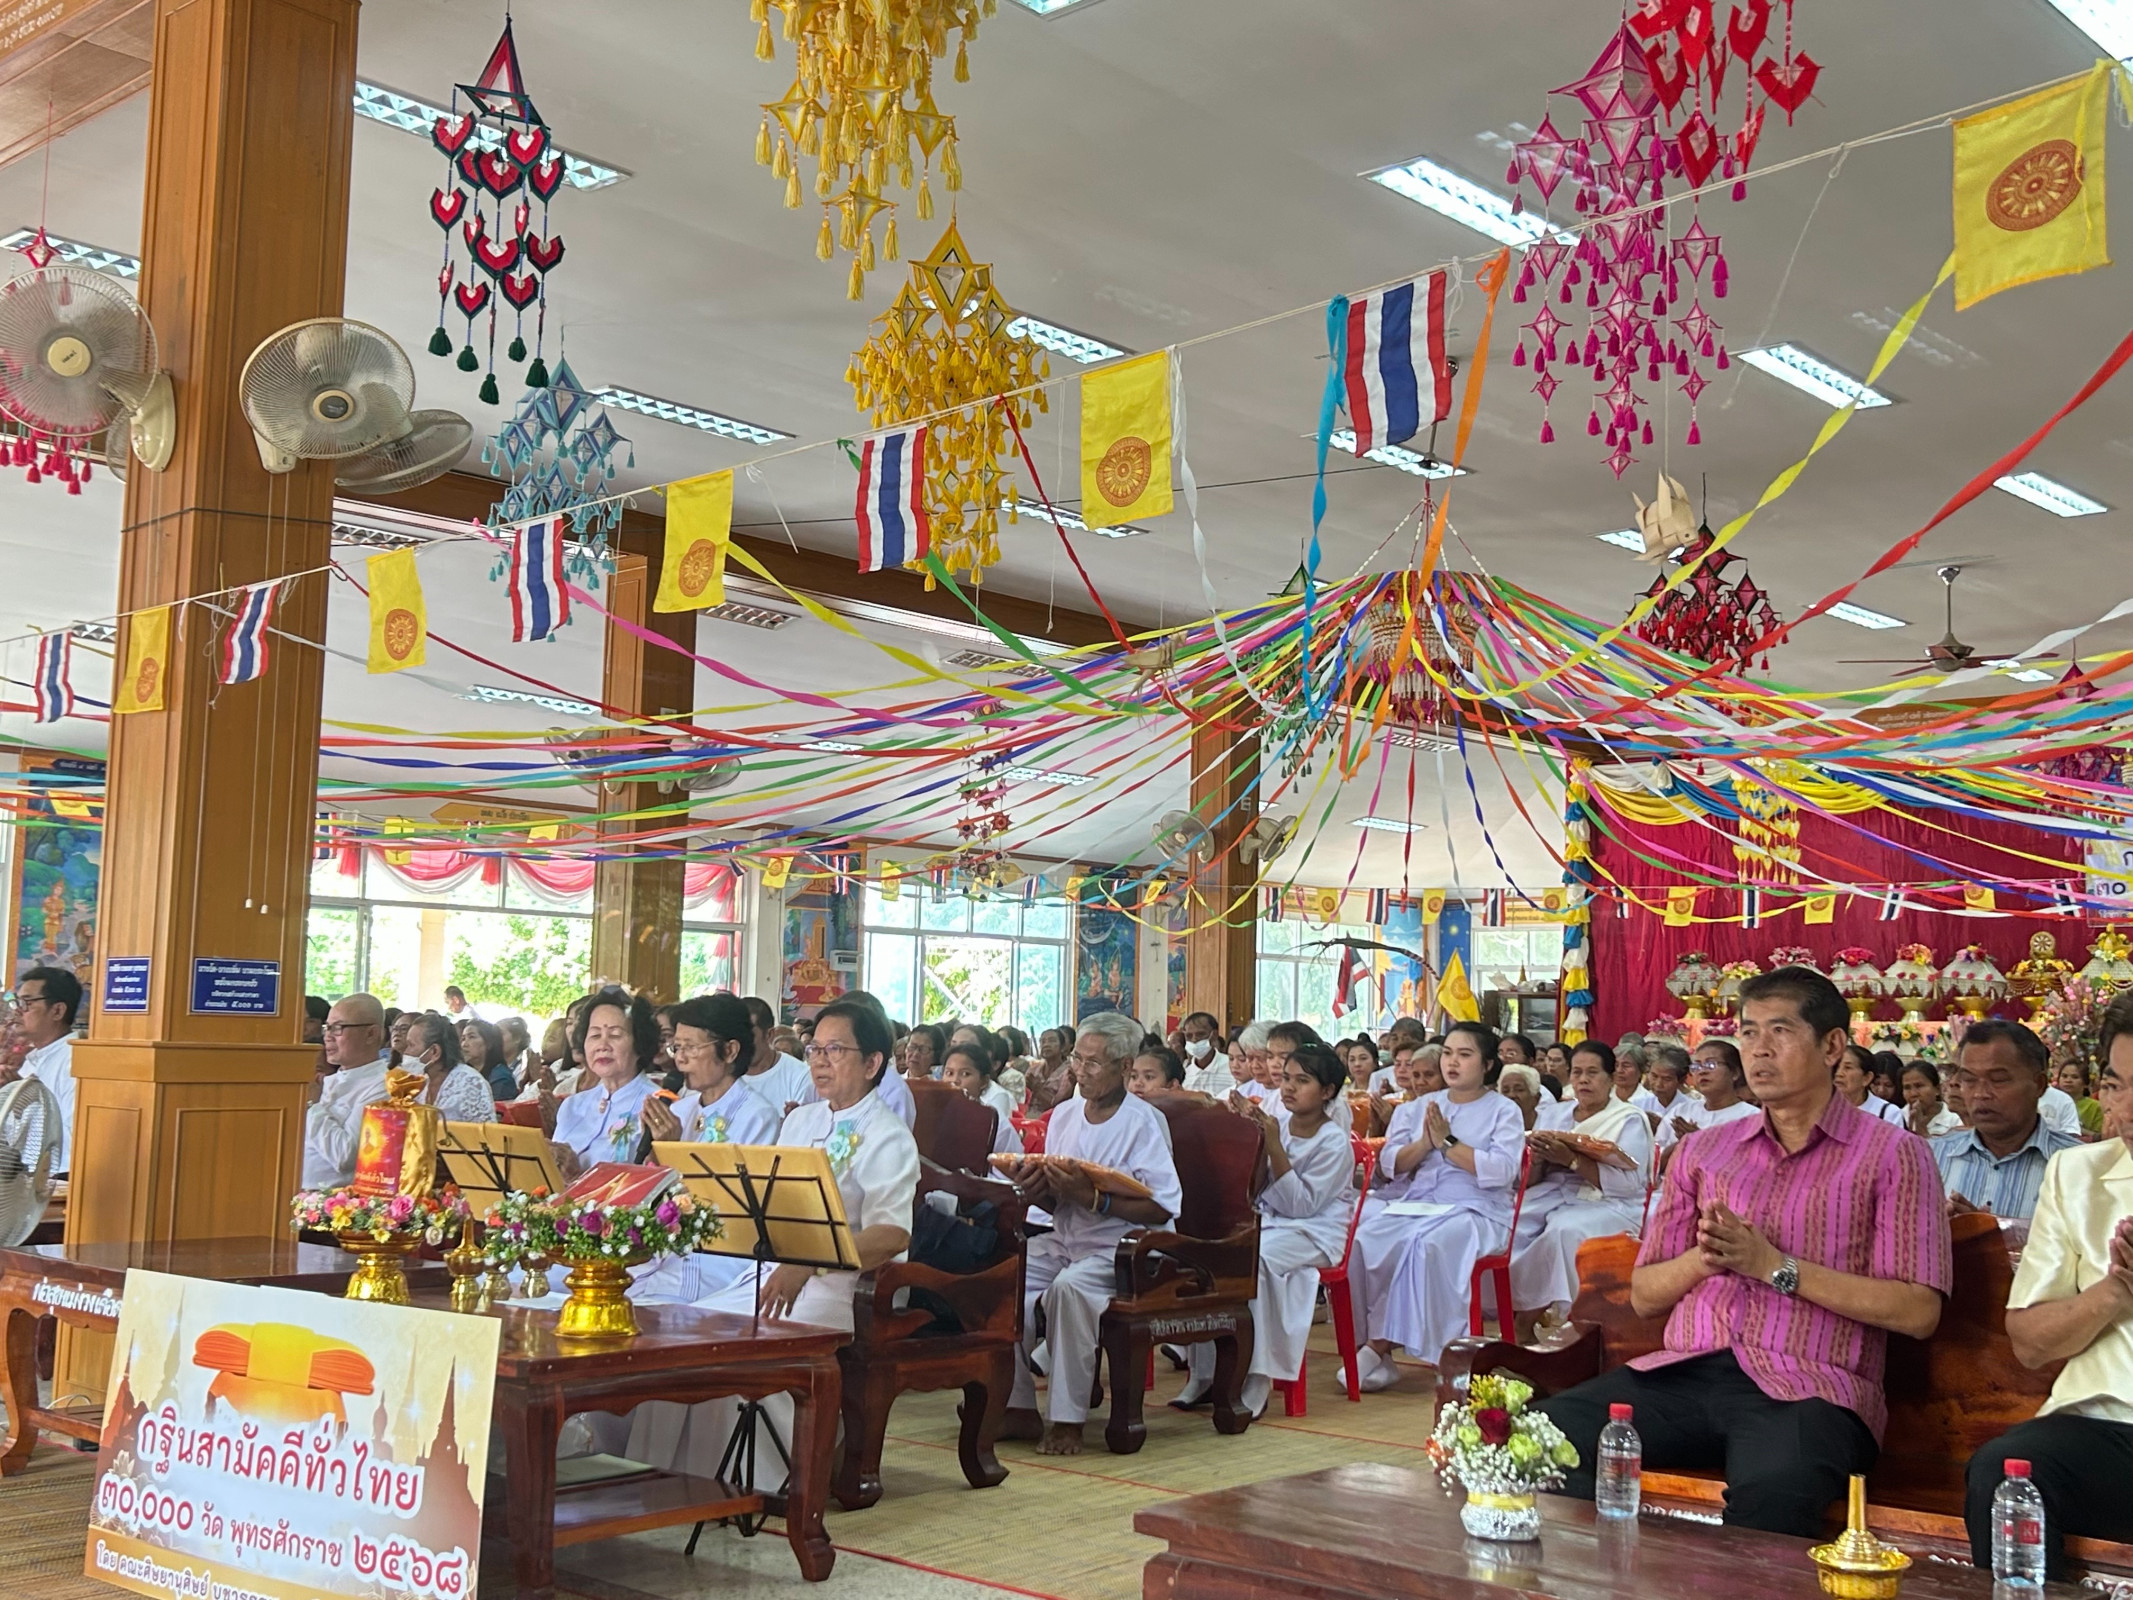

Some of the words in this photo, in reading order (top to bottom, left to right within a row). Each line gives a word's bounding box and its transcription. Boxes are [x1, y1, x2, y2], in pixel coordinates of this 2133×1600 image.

[141, 1406, 419, 1511] กฐินสามัคคีทั่วไทย
[97, 1543, 117, 1568] โดย
[101, 1480, 194, 1531] ๓๐,๐๐๐
[201, 1500, 224, 1540] วัด
[230, 1518, 343, 1567] พุทธศักราช
[353, 1534, 463, 1595] ๒๕๖๘
